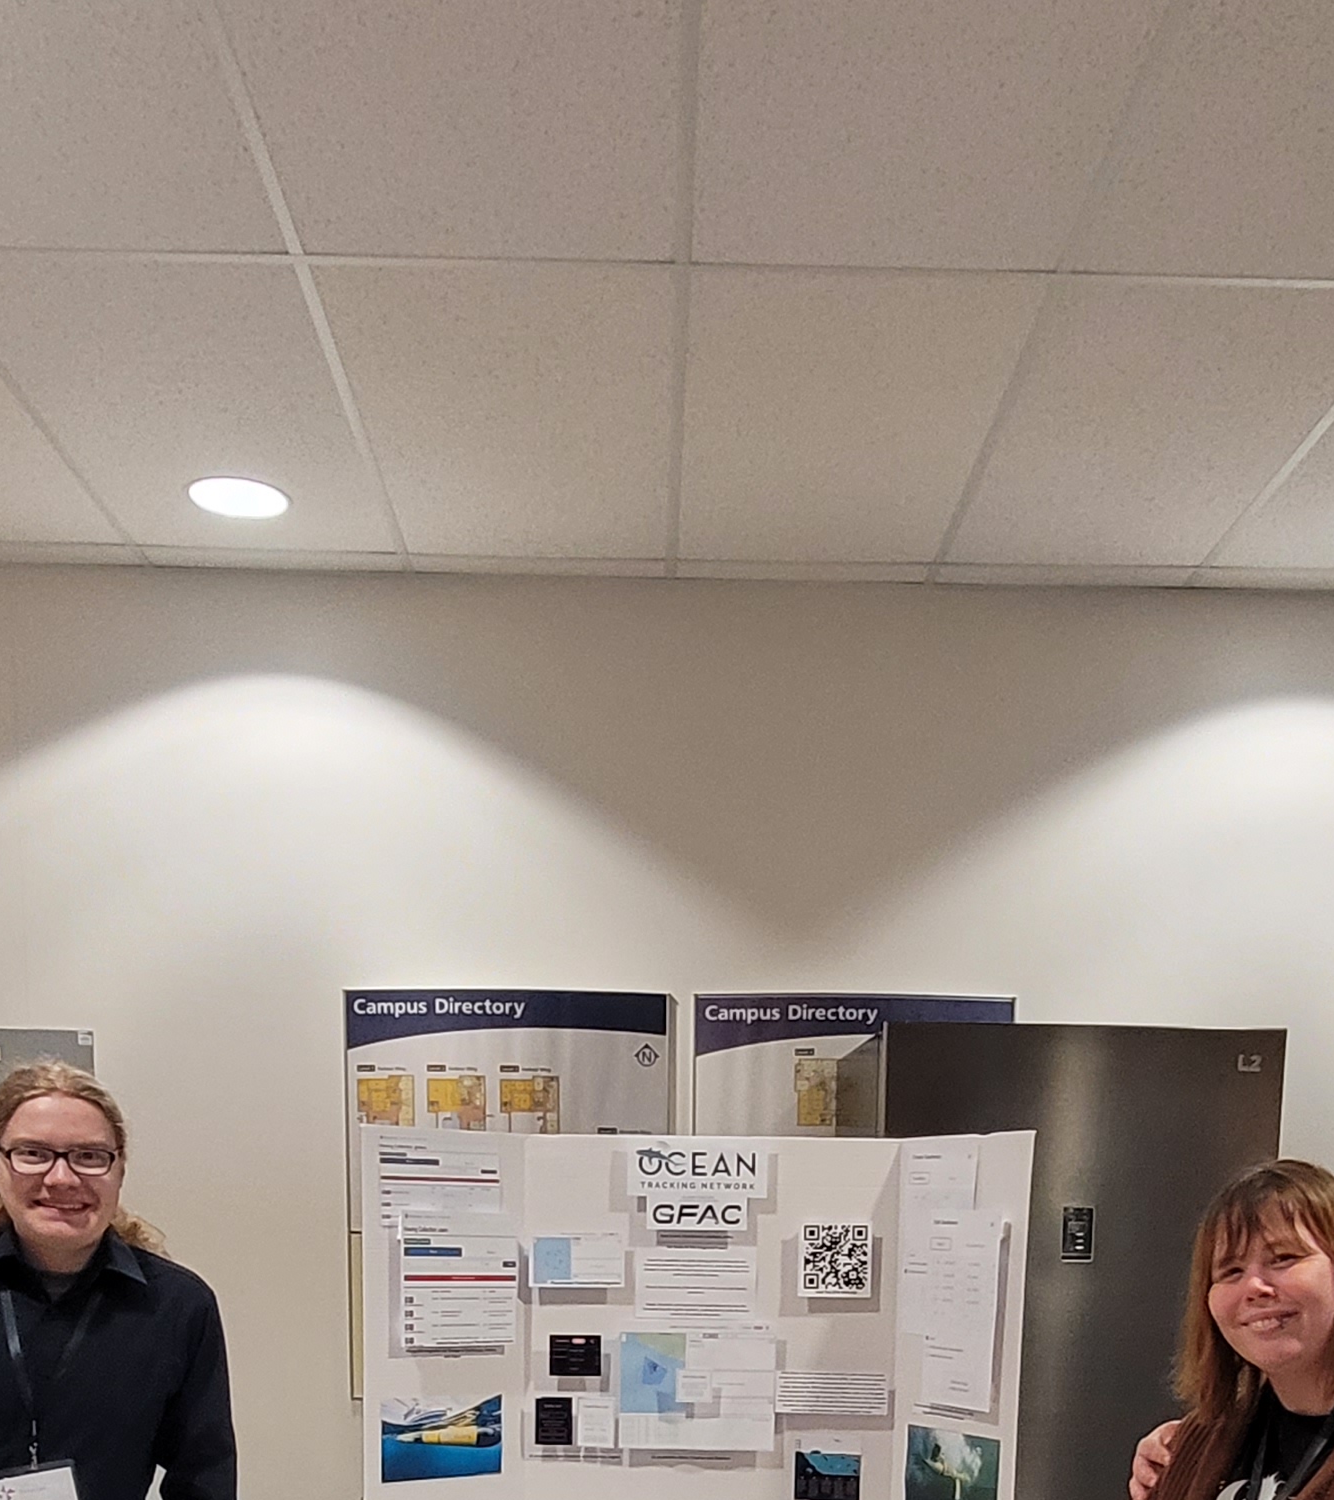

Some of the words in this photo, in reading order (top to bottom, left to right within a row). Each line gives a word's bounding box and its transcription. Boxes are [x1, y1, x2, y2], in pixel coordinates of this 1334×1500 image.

[353, 998, 428, 1018] Campus
[434, 996, 526, 1019] Directory
[704, 1004, 781, 1024] Campus
[787, 1003, 879, 1025] Directory
[641, 1051, 652, 1063] N
[638, 1150, 756, 1177] OCEAN
[640, 1181, 697, 1190] TRACKING
[700, 1181, 756, 1191] NETWORK
[652, 1203, 743, 1225] GFAC
